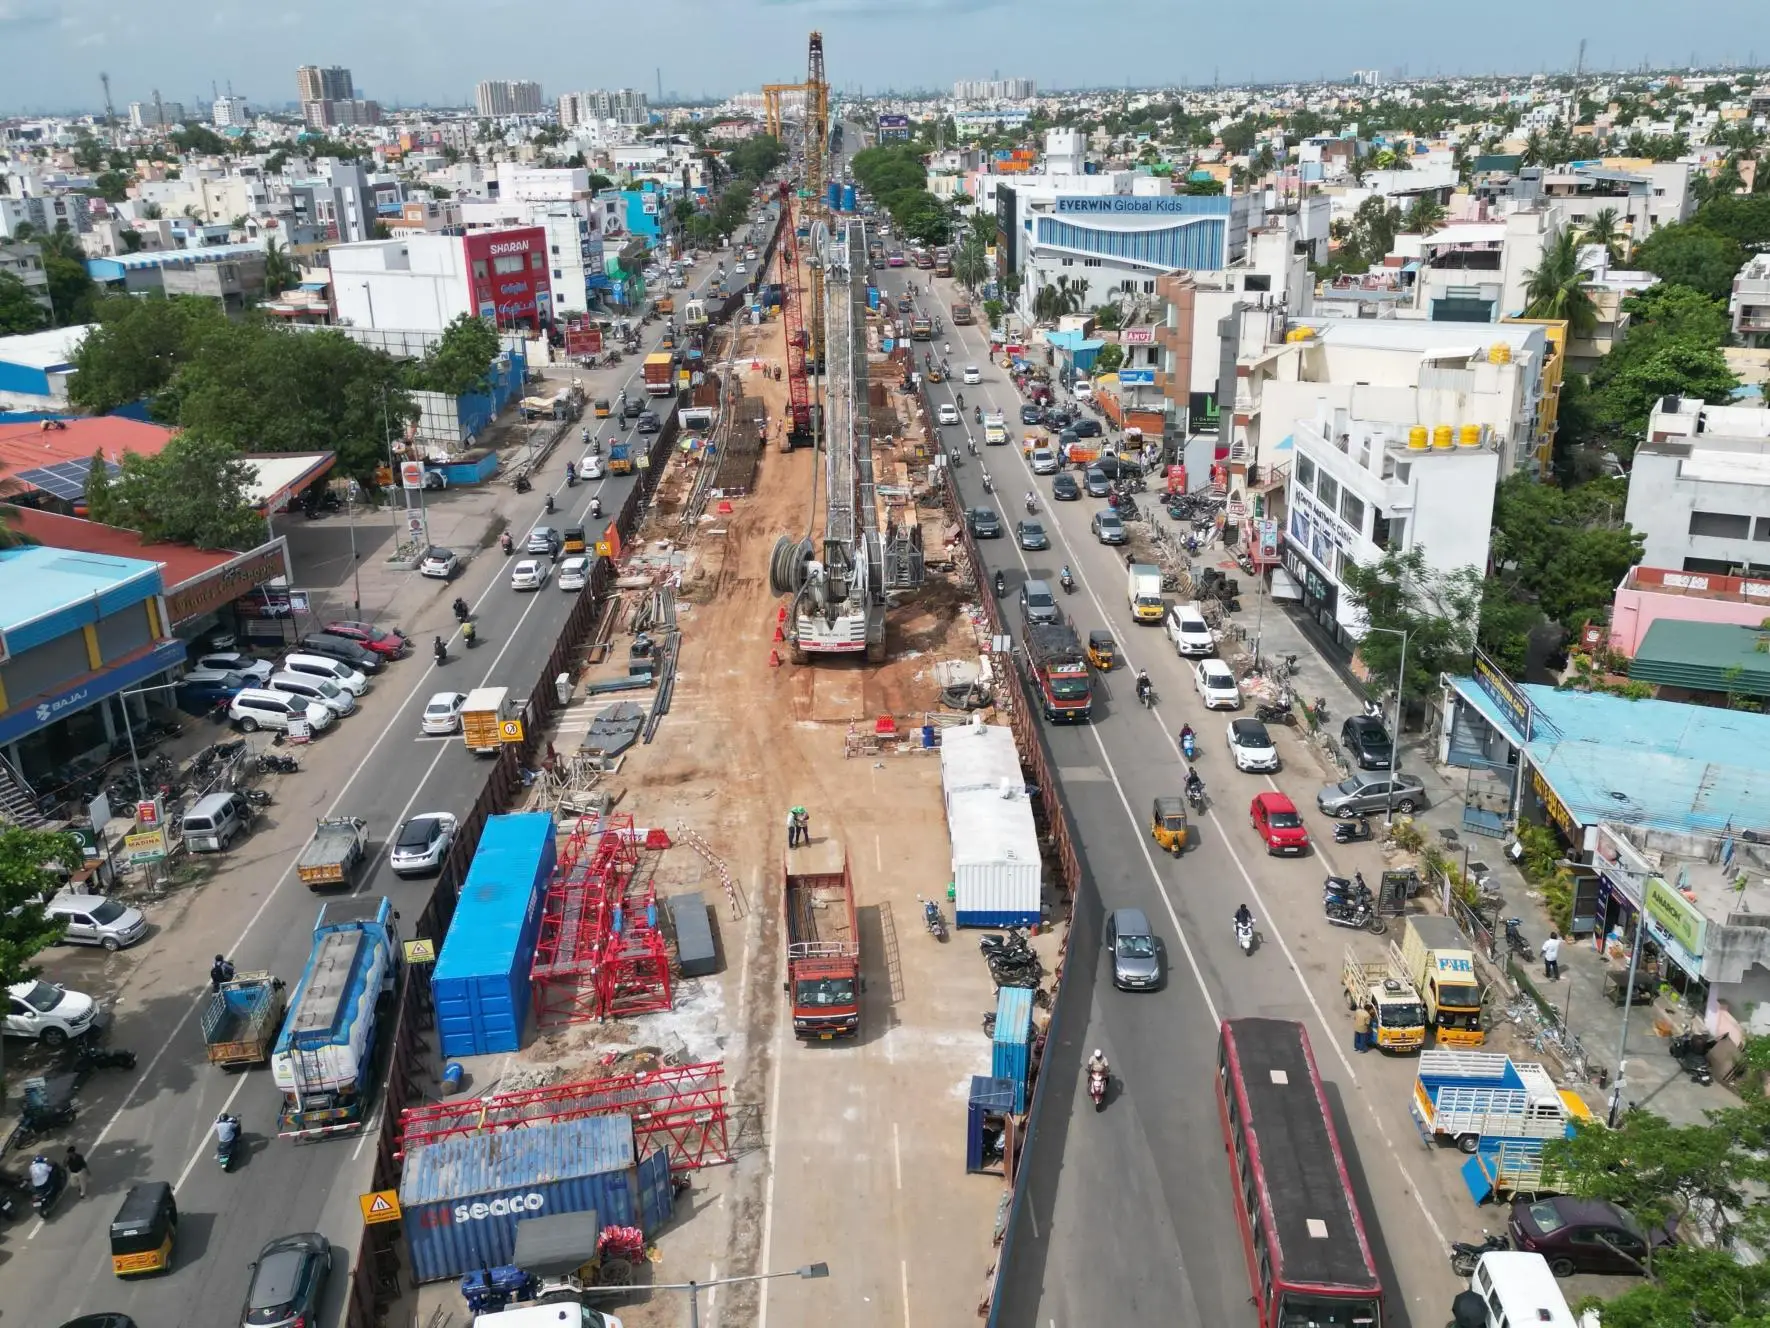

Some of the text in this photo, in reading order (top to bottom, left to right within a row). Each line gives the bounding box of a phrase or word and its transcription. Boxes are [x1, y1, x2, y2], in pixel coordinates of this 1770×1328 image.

[1059, 199, 1182, 211] EVERWIN Global Kids
[490, 240, 529, 254] SHARAN
[1337, 525, 1352, 545] Clinic
[1287, 548, 1307, 585] TITAN
[52, 689, 88, 712] BAJAJ
[454, 1193, 544, 1224] seaco
